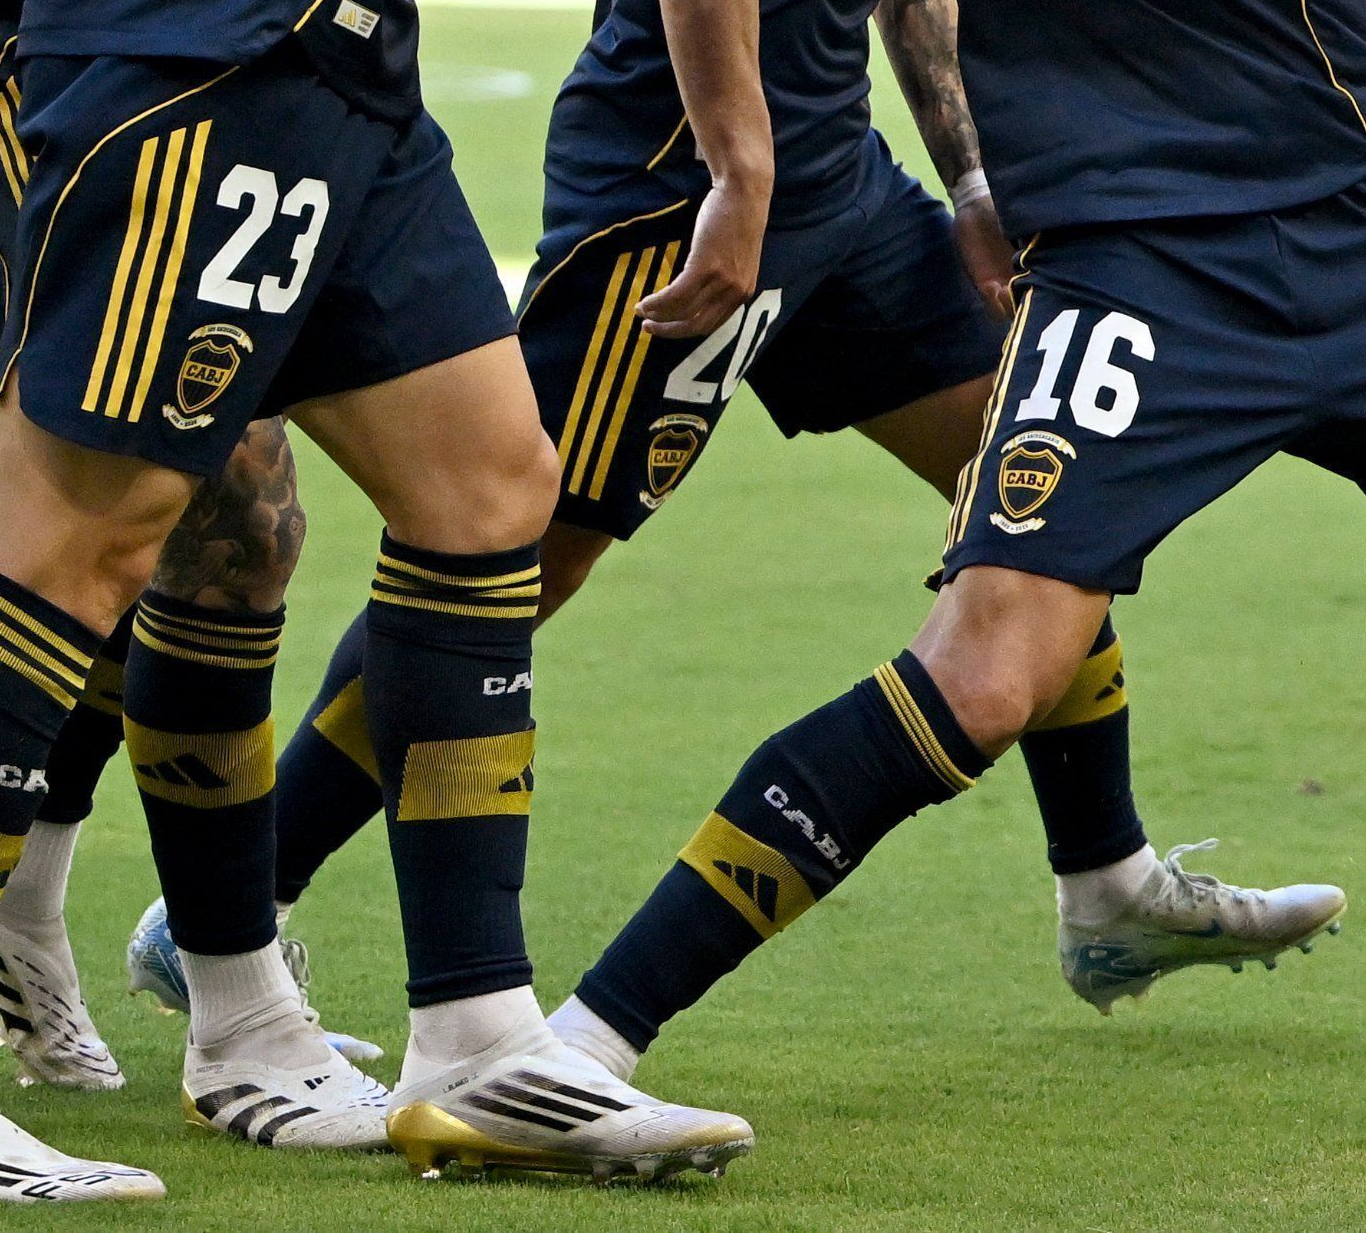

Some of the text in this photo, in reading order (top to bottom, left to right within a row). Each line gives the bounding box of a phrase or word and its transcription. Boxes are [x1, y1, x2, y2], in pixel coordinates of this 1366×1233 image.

[197, 163, 330, 314] 23
[186, 364, 226, 384] CABJ
[663, 287, 783, 404] 20
[1015, 309, 1156, 438] 16
[1006, 472, 1049, 488] CABJ
[482, 671, 533, 696] CA
